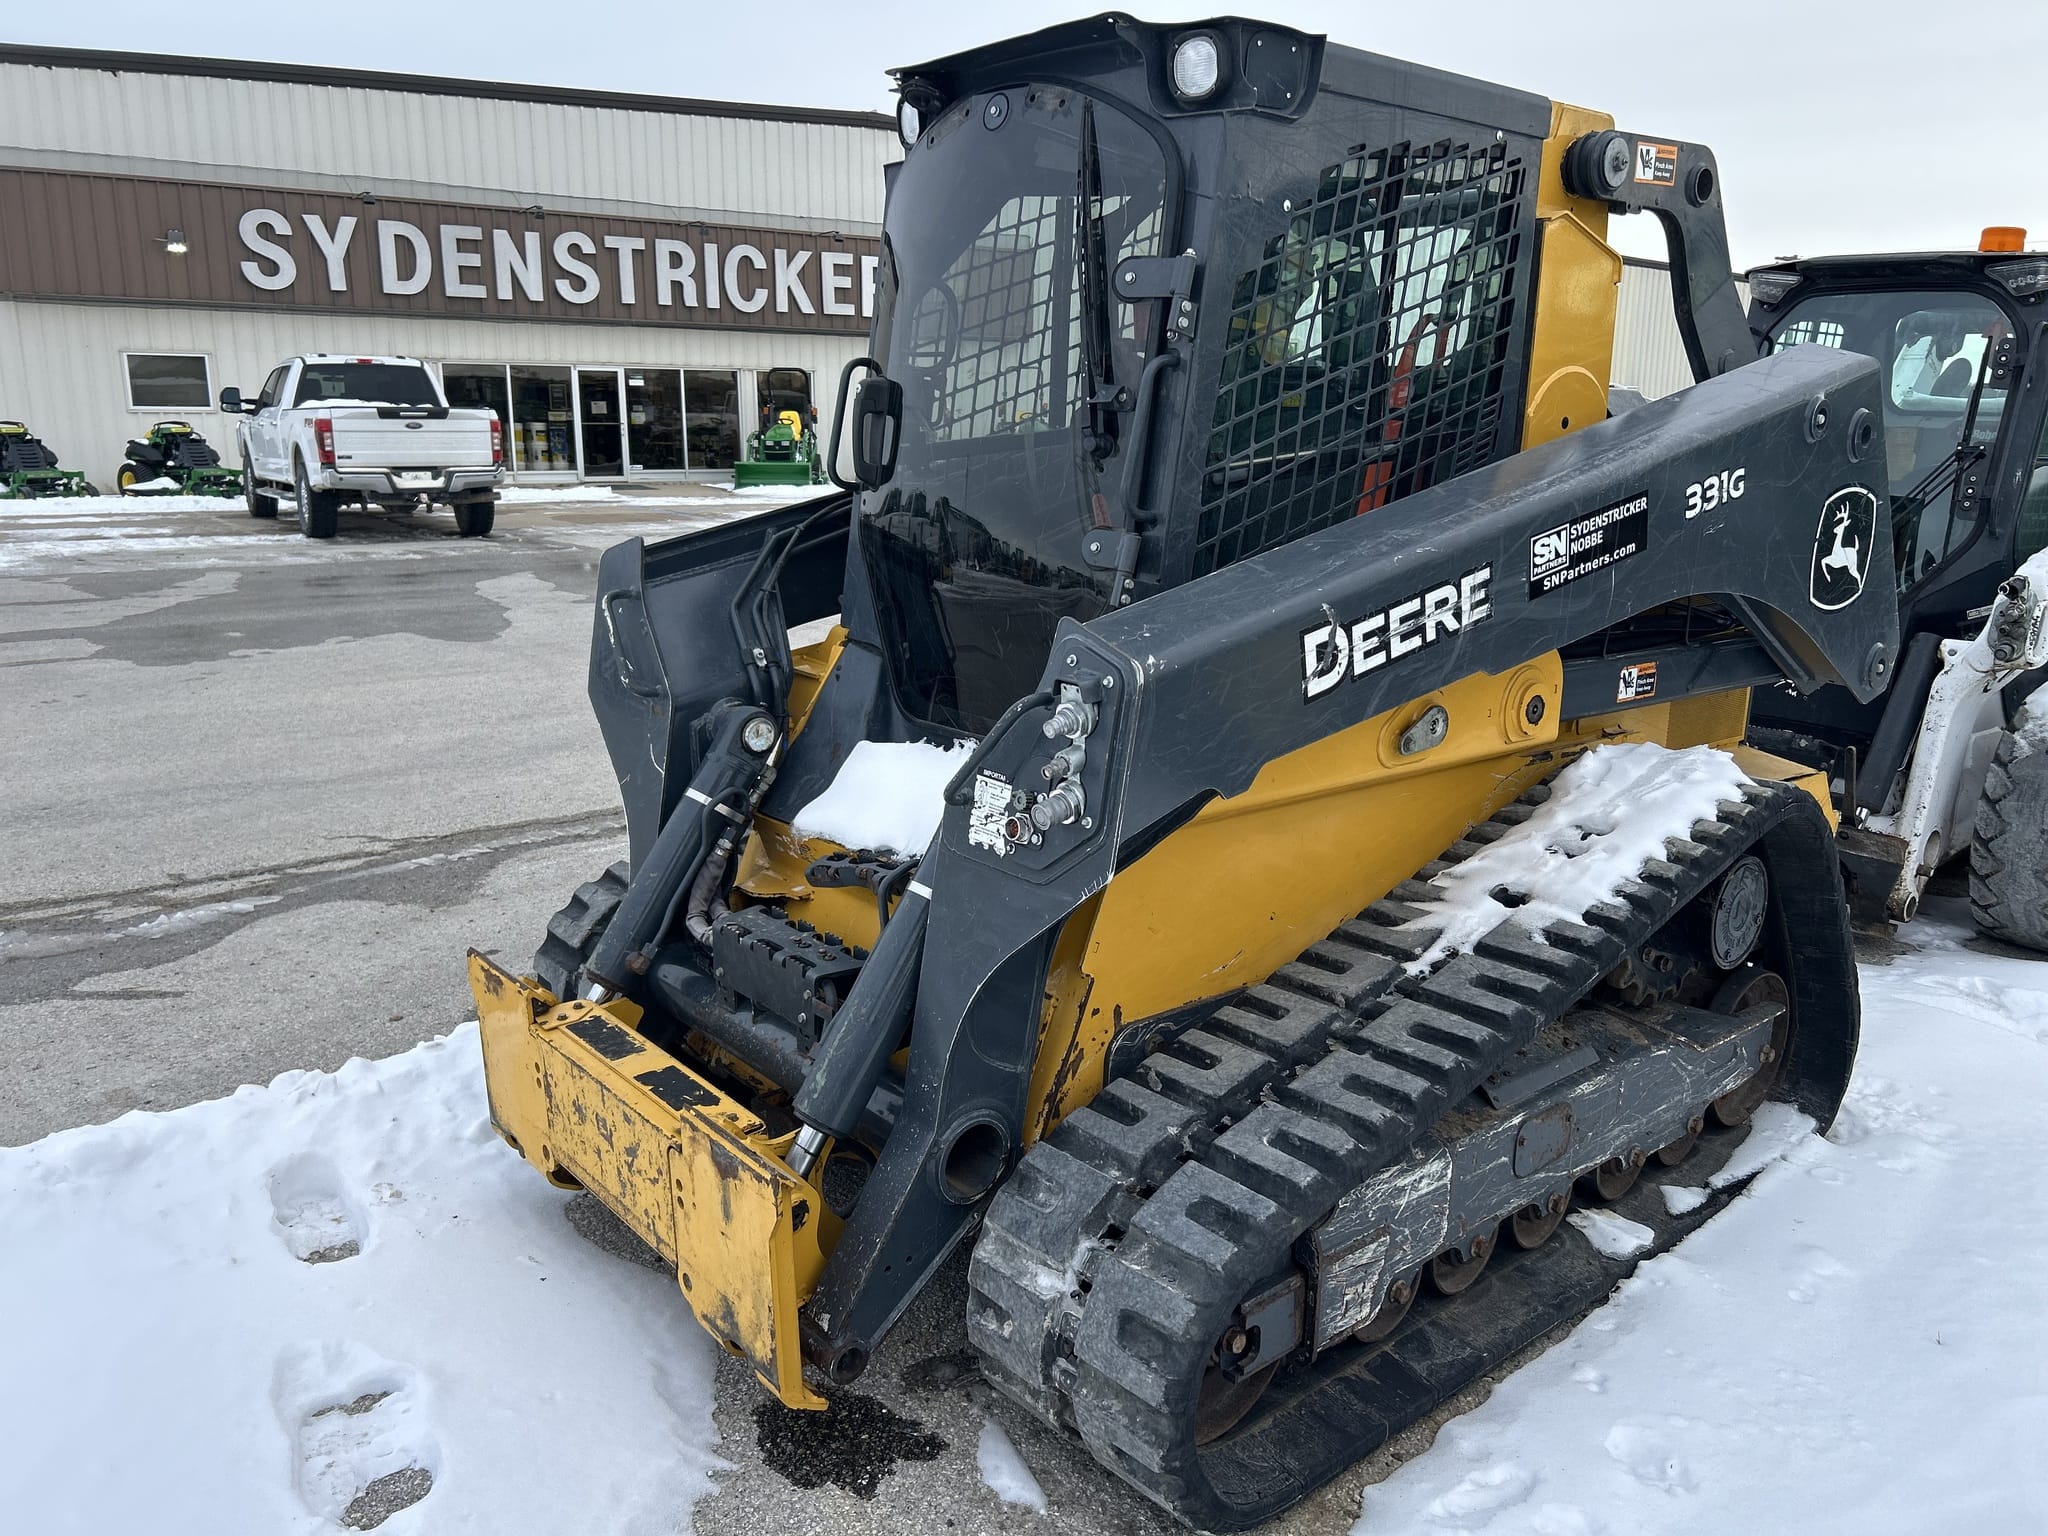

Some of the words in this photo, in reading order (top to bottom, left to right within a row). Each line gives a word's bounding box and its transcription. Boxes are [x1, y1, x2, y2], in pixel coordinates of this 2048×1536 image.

[1684, 467, 1746, 519] 331G
[1570, 496, 1648, 539] SYDENSTRICKER
[1533, 529, 1567, 566] SN
[1570, 530, 1604, 556] NOBBE
[1533, 555, 1567, 576] PARTNERS
[1543, 541, 1636, 591] SNPartners.com
[1302, 566, 1493, 699] DEERE
[983, 768, 1006, 781] IMPORTA
